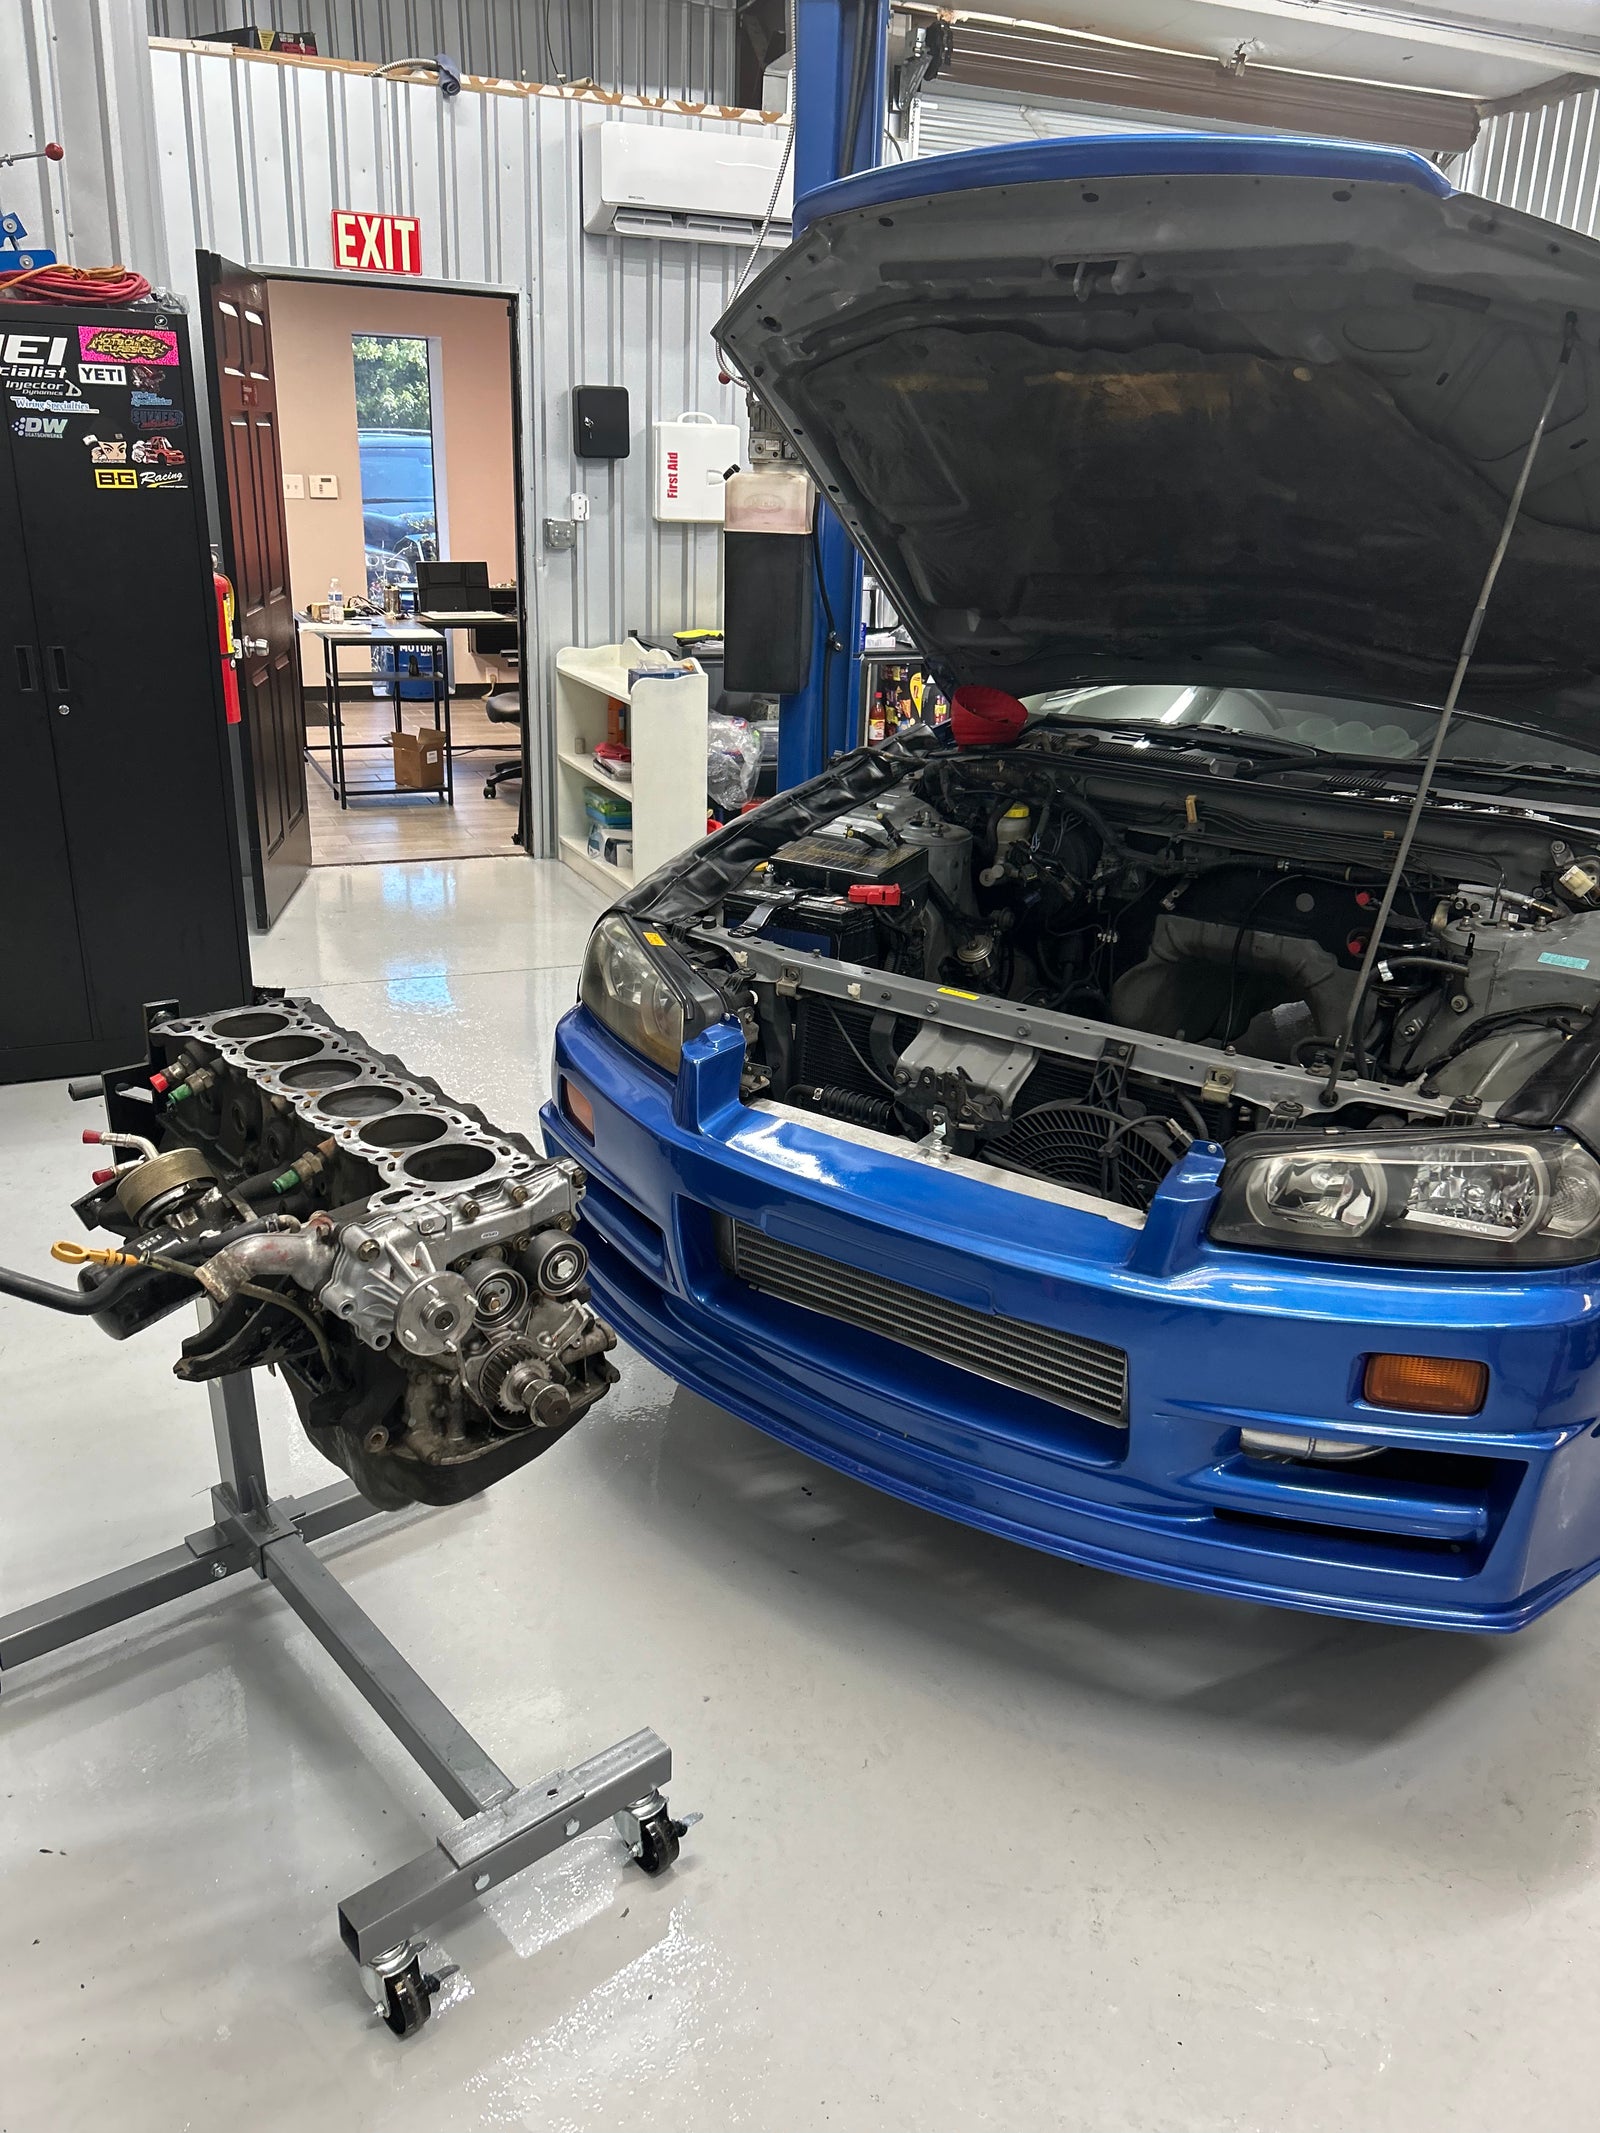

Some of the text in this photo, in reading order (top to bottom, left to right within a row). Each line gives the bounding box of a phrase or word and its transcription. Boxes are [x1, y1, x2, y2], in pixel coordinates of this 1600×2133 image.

[336, 213, 416, 272] EXIT
[81, 367, 123, 382] YETI
[5, 380, 65, 391] Injector
[16, 399, 45, 411] Wiring
[46, 399, 89, 411] Specialties
[24, 417, 68, 434] DW
[140, 471, 183, 484] Racing
[667, 452, 678, 498] First Aid
